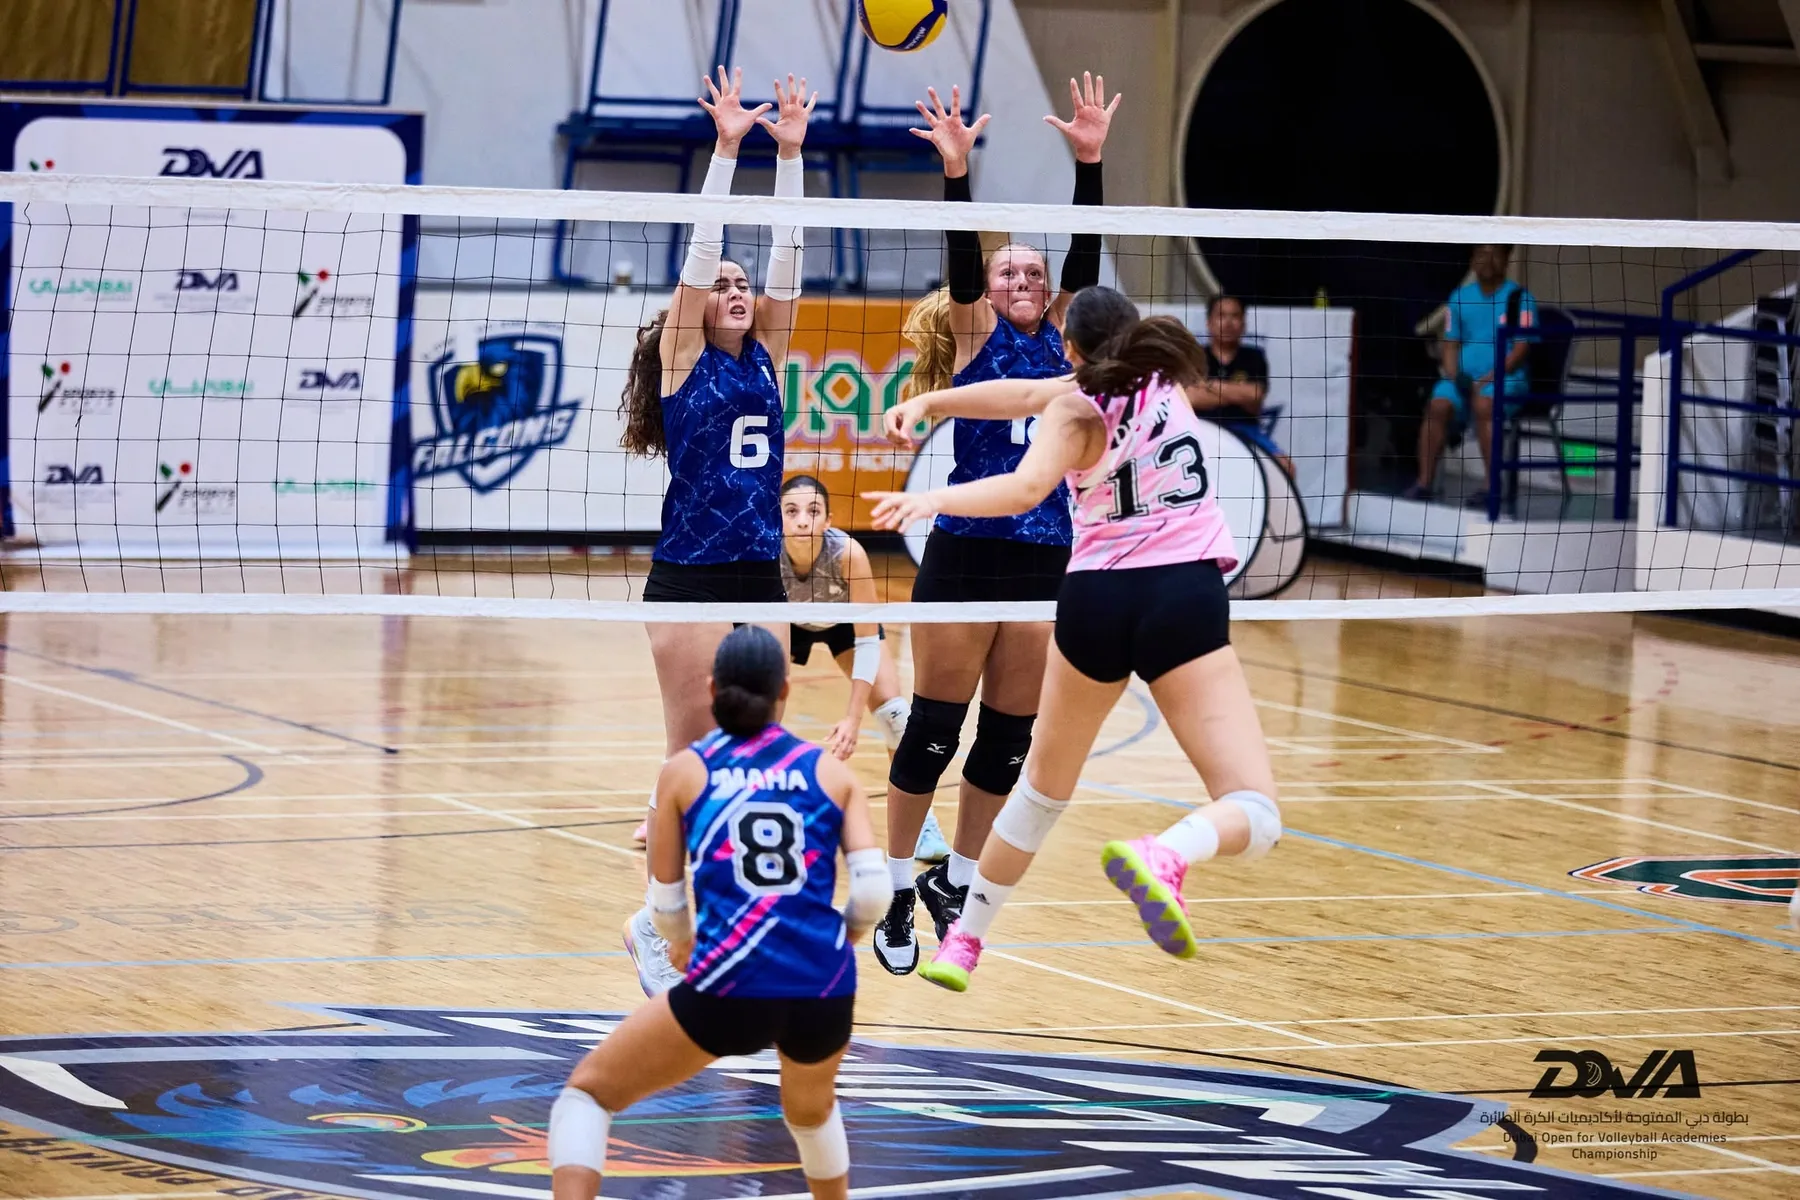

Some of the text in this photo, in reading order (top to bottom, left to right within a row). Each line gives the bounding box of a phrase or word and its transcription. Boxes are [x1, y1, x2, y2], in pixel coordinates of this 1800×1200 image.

[412, 410, 573, 473] FALCONS
[729, 415, 770, 469] 6
[1104, 431, 1209, 524] 13
[727, 801, 808, 896] 8
